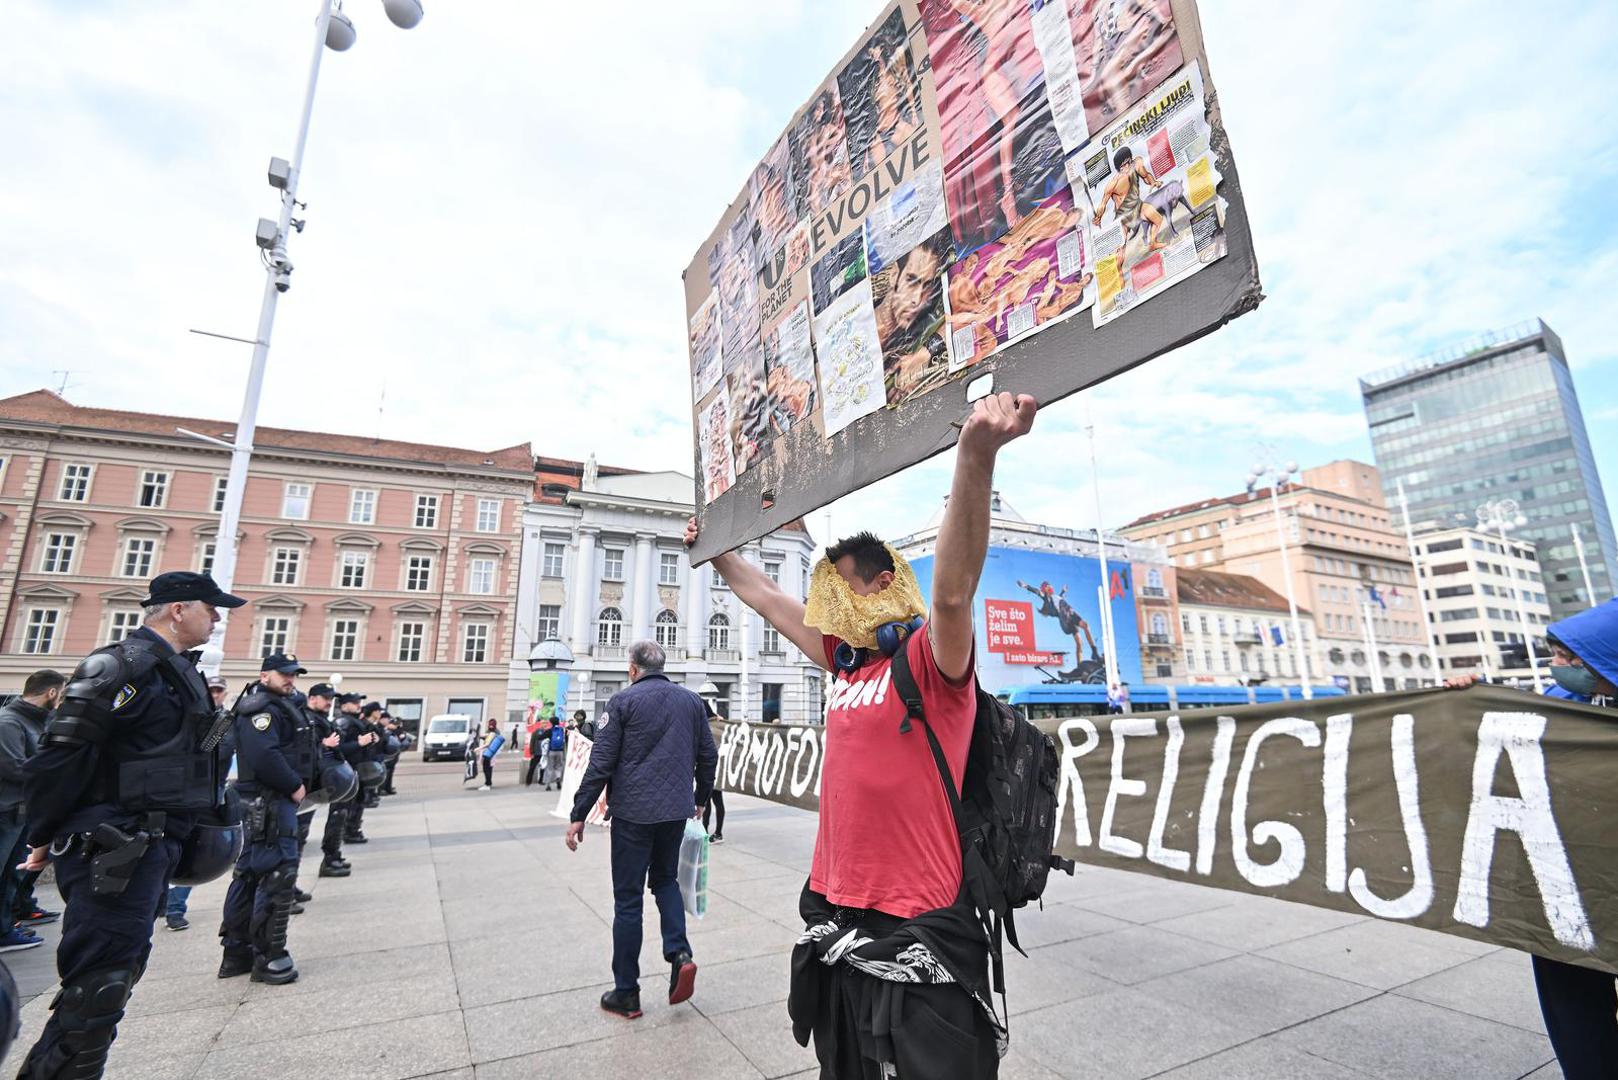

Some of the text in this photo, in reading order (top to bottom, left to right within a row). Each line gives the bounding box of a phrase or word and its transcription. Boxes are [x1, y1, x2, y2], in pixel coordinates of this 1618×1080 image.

[1160, 79, 1192, 110] LJUDI
[812, 129, 930, 253] EVOLVE
[761, 277, 792, 314] FOR THE
[761, 286, 793, 325] PLANET
[1110, 567, 1130, 600] A1
[988, 605, 1026, 621] Sve što
[988, 619, 1018, 633] želim
[989, 631, 1024, 647] je sve.
[1053, 711, 1596, 952] RELIGIJA
